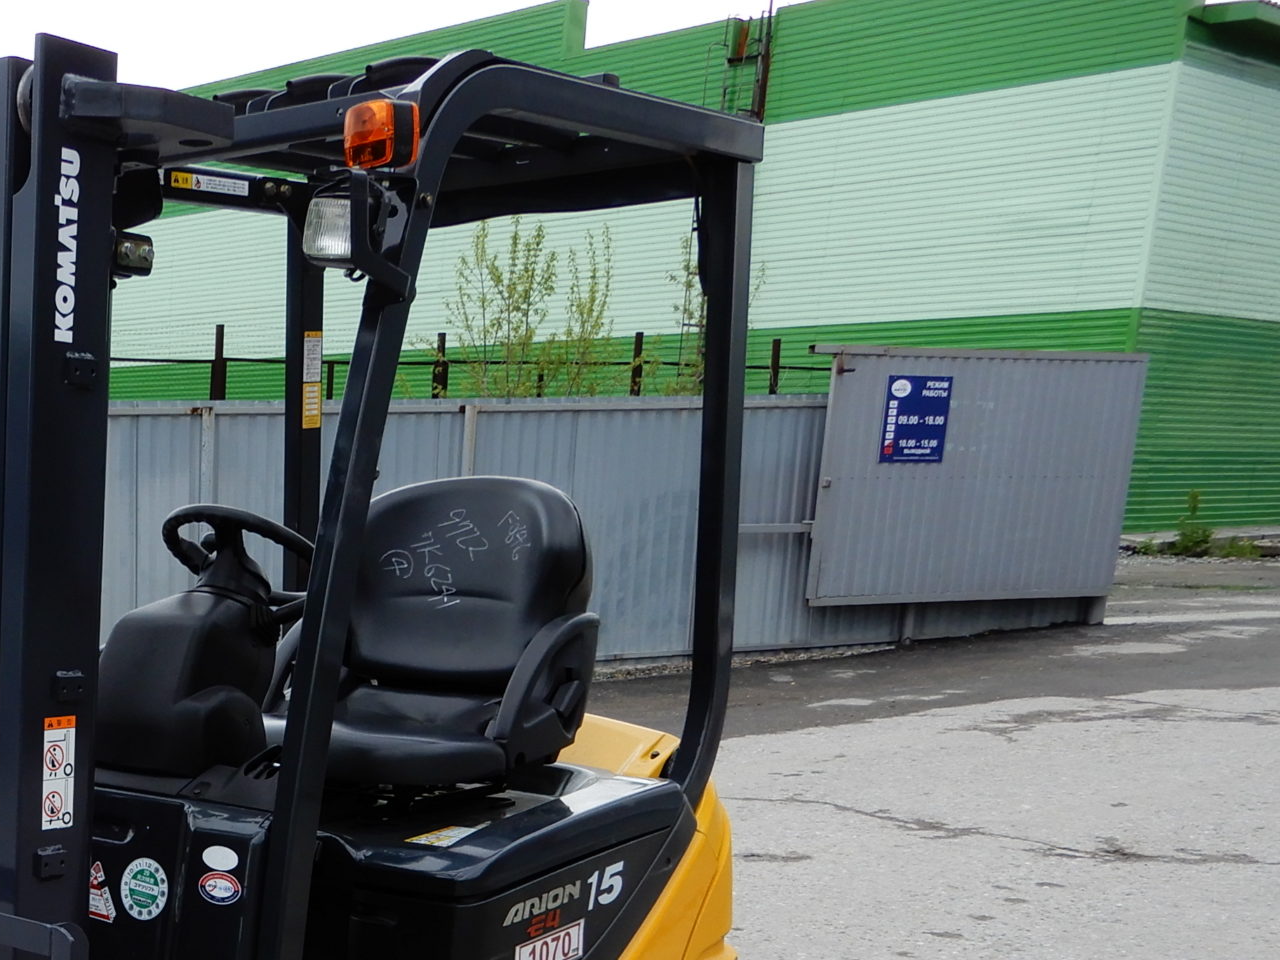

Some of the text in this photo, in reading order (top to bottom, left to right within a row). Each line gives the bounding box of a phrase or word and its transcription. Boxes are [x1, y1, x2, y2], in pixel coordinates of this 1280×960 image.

[54, 147, 81, 343] KOMATSU
[922, 389, 948, 397] РАБОТЫ
[897, 416, 918, 425] 09.00
[924, 416, 945, 425] 18.00
[502, 861, 624, 927] ARION 15
